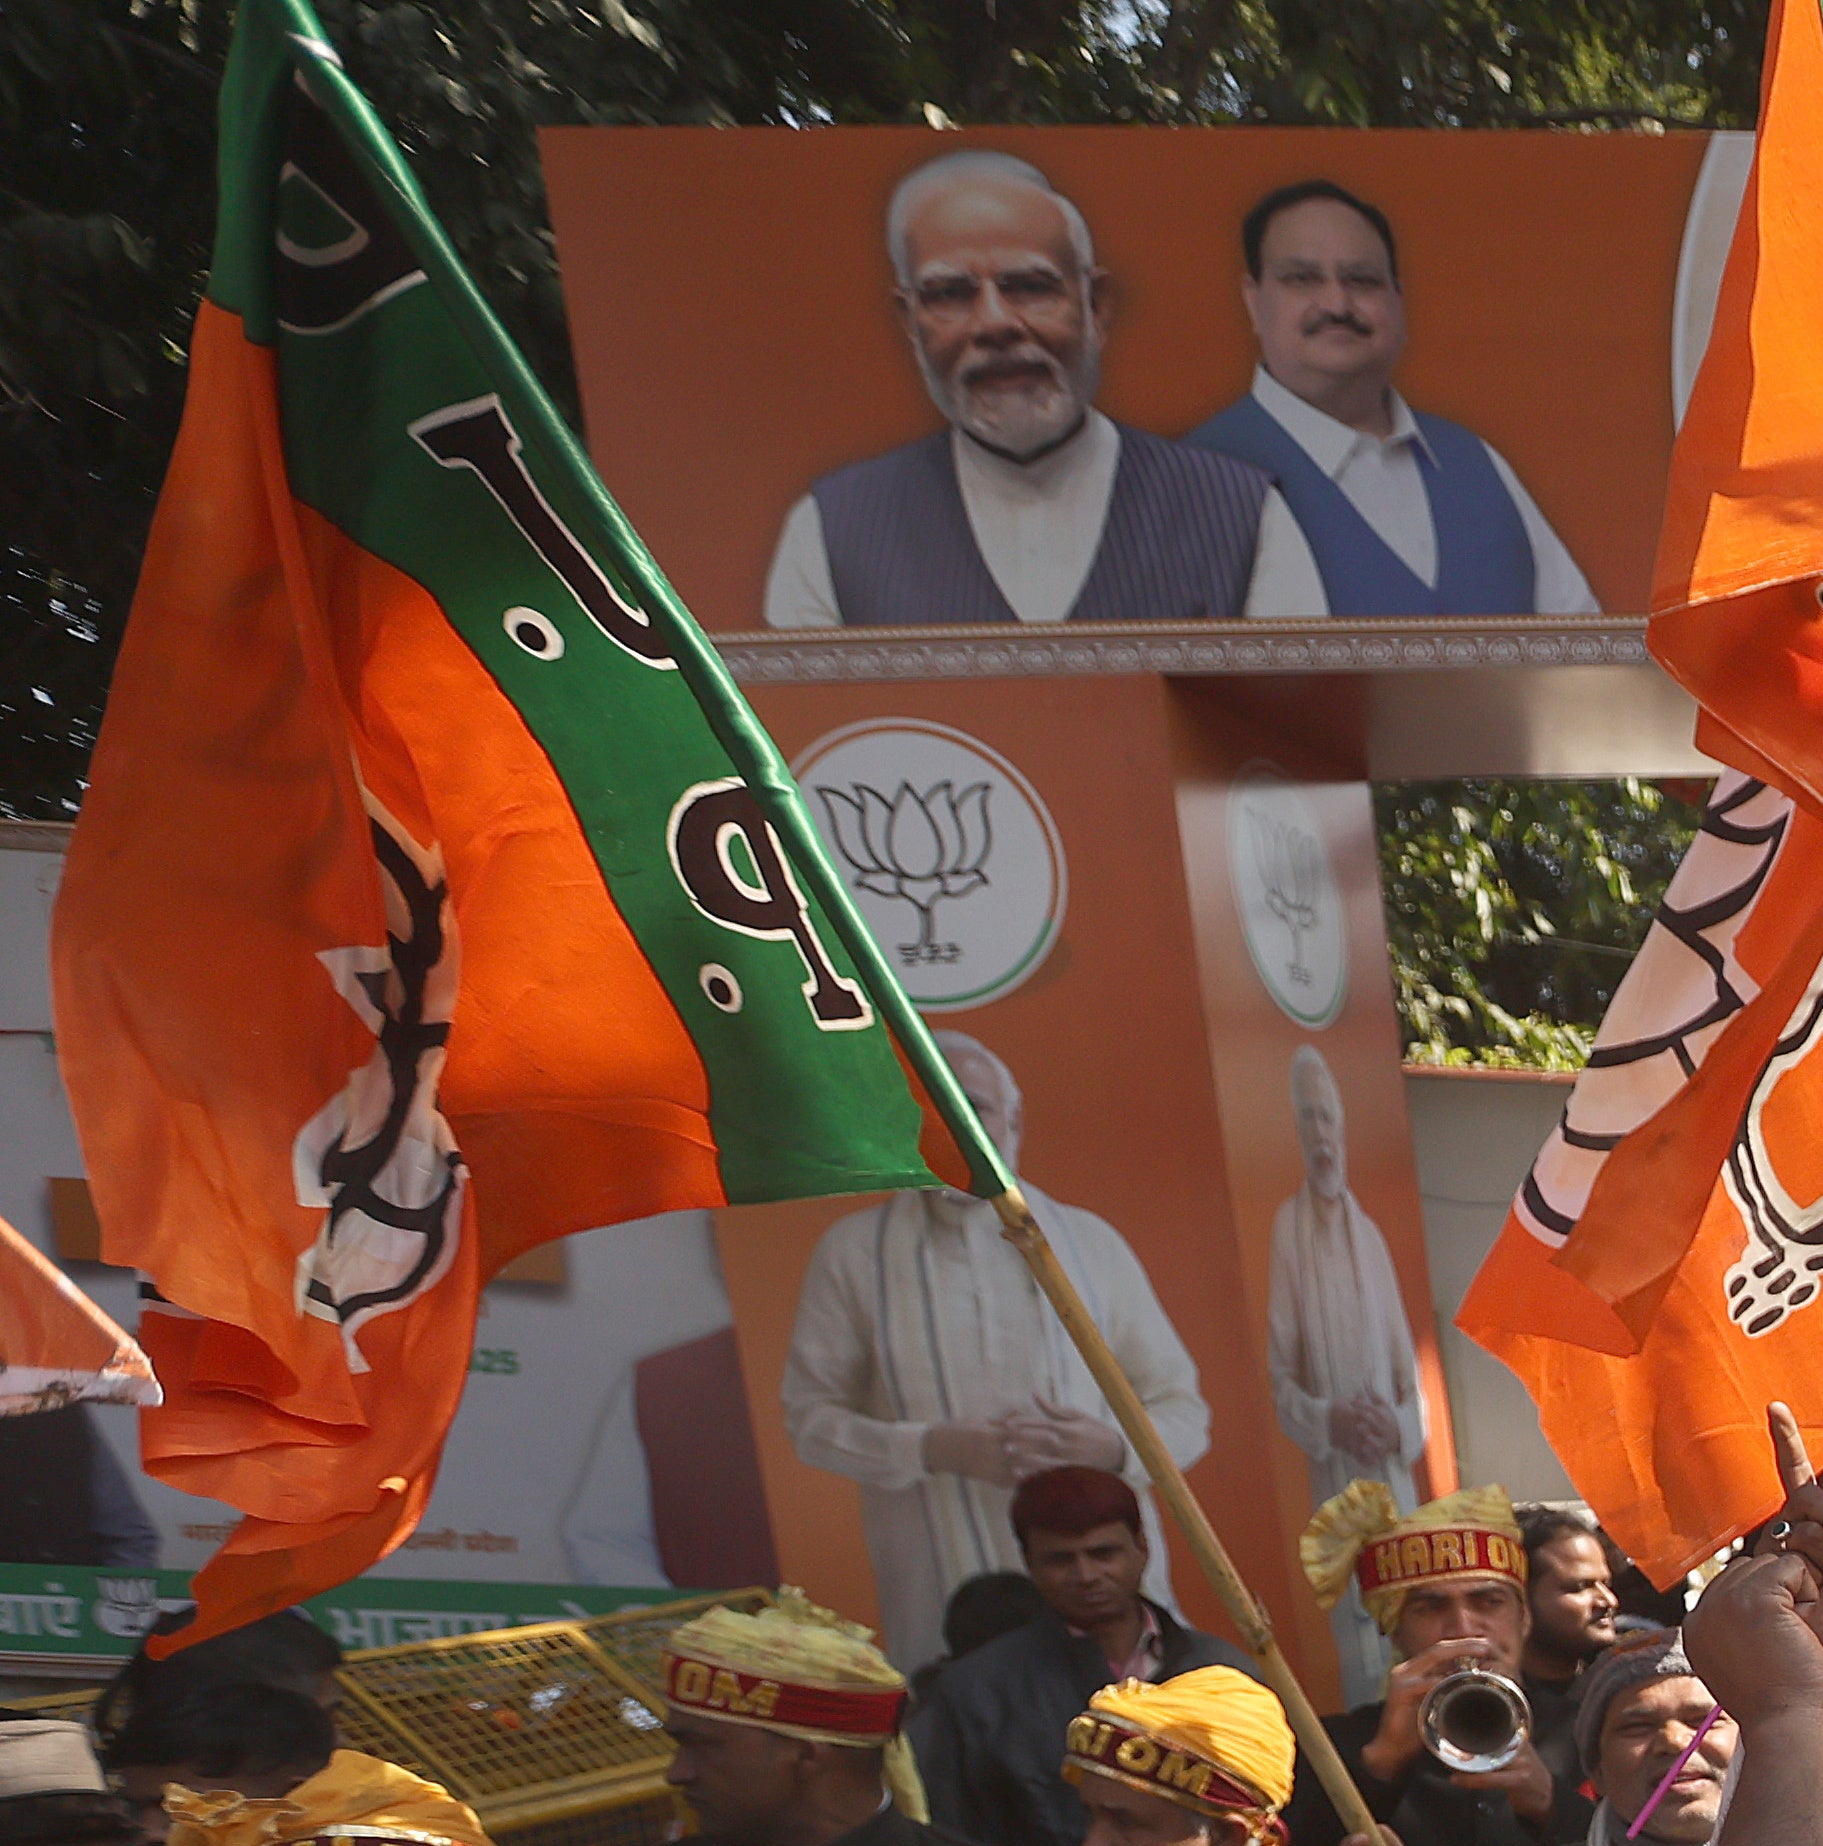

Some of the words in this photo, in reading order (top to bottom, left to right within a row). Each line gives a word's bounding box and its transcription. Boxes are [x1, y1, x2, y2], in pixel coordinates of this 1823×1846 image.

[1374, 1531, 1479, 1581] HARI
[676, 1661, 781, 1717] OM
[1066, 1716, 1115, 1756] RI
[1115, 1735, 1213, 1796] OM
